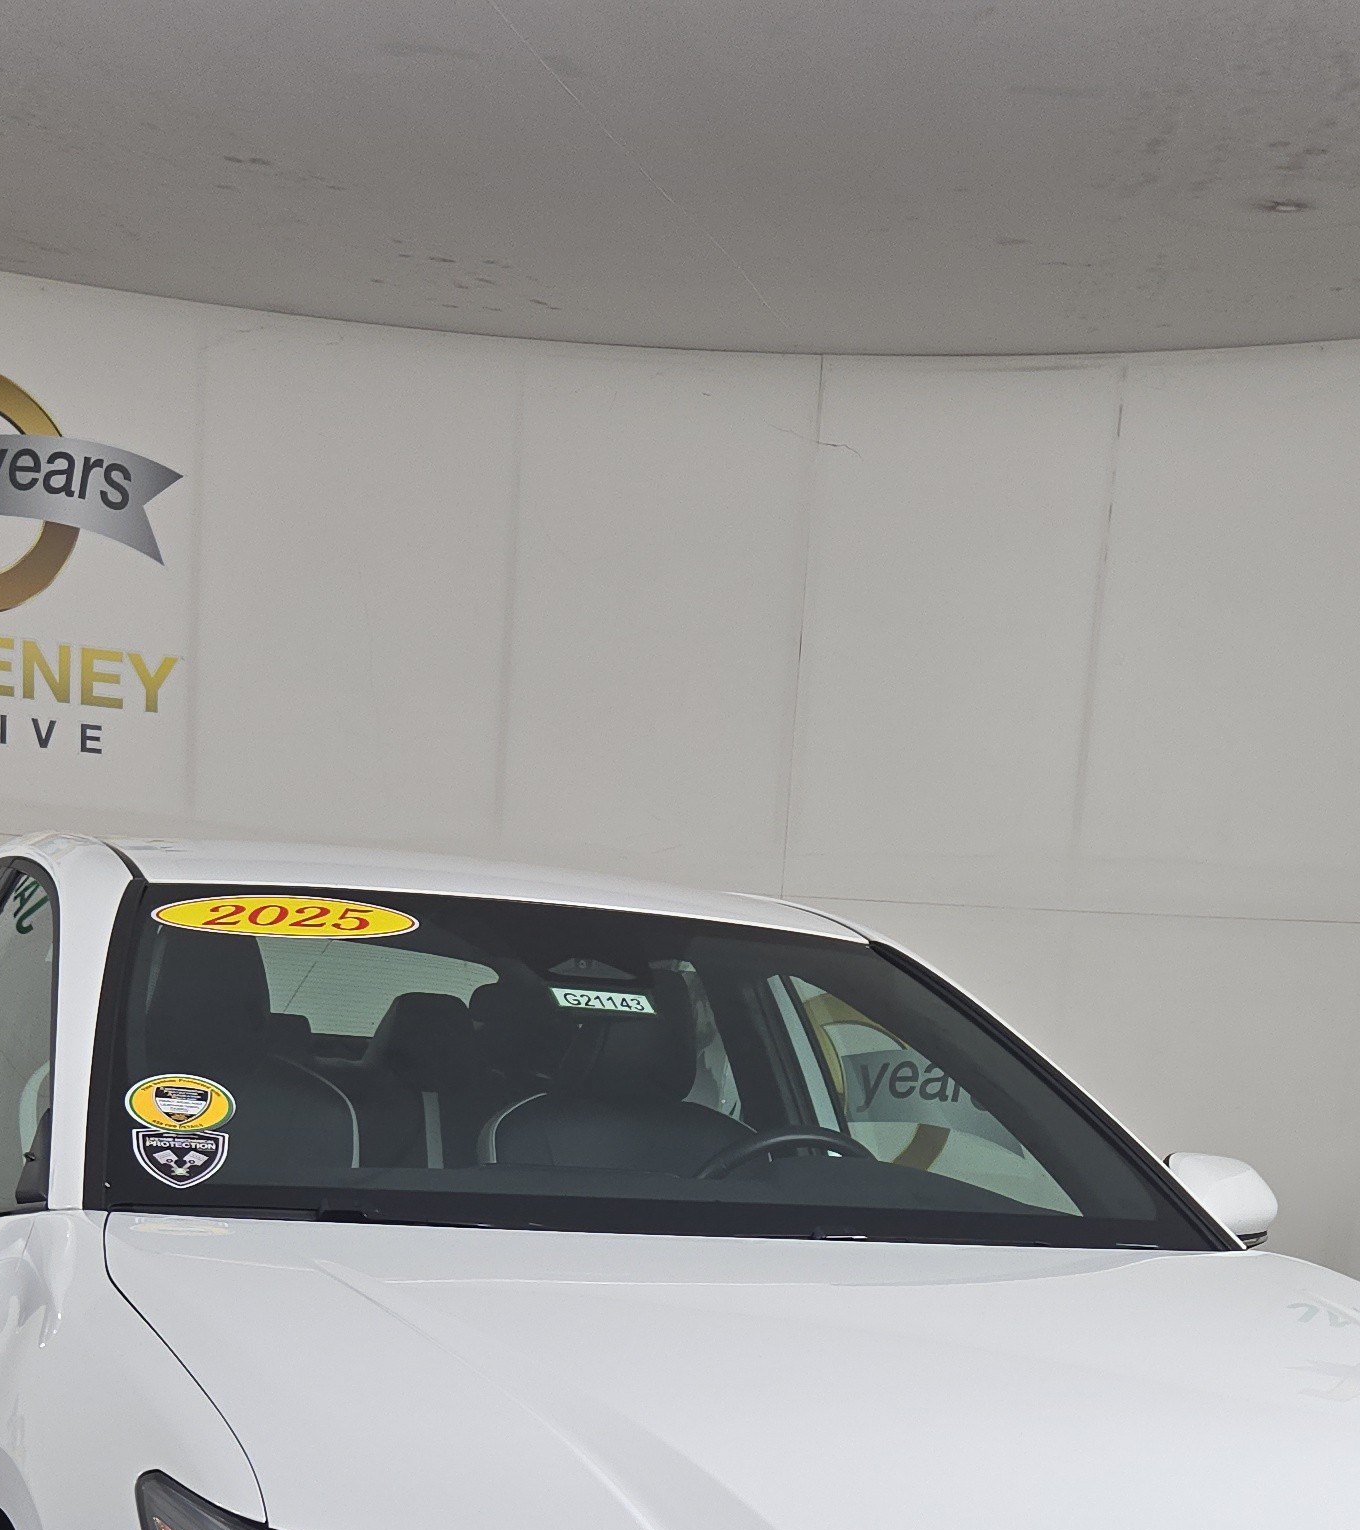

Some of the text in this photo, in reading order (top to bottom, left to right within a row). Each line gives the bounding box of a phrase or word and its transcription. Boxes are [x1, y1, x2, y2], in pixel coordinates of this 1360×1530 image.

[202, 904, 372, 931] 2025
[563, 992, 645, 1012] G21143
[856, 1060, 989, 1112] yea
[145, 1140, 217, 1149] PROTECTION
